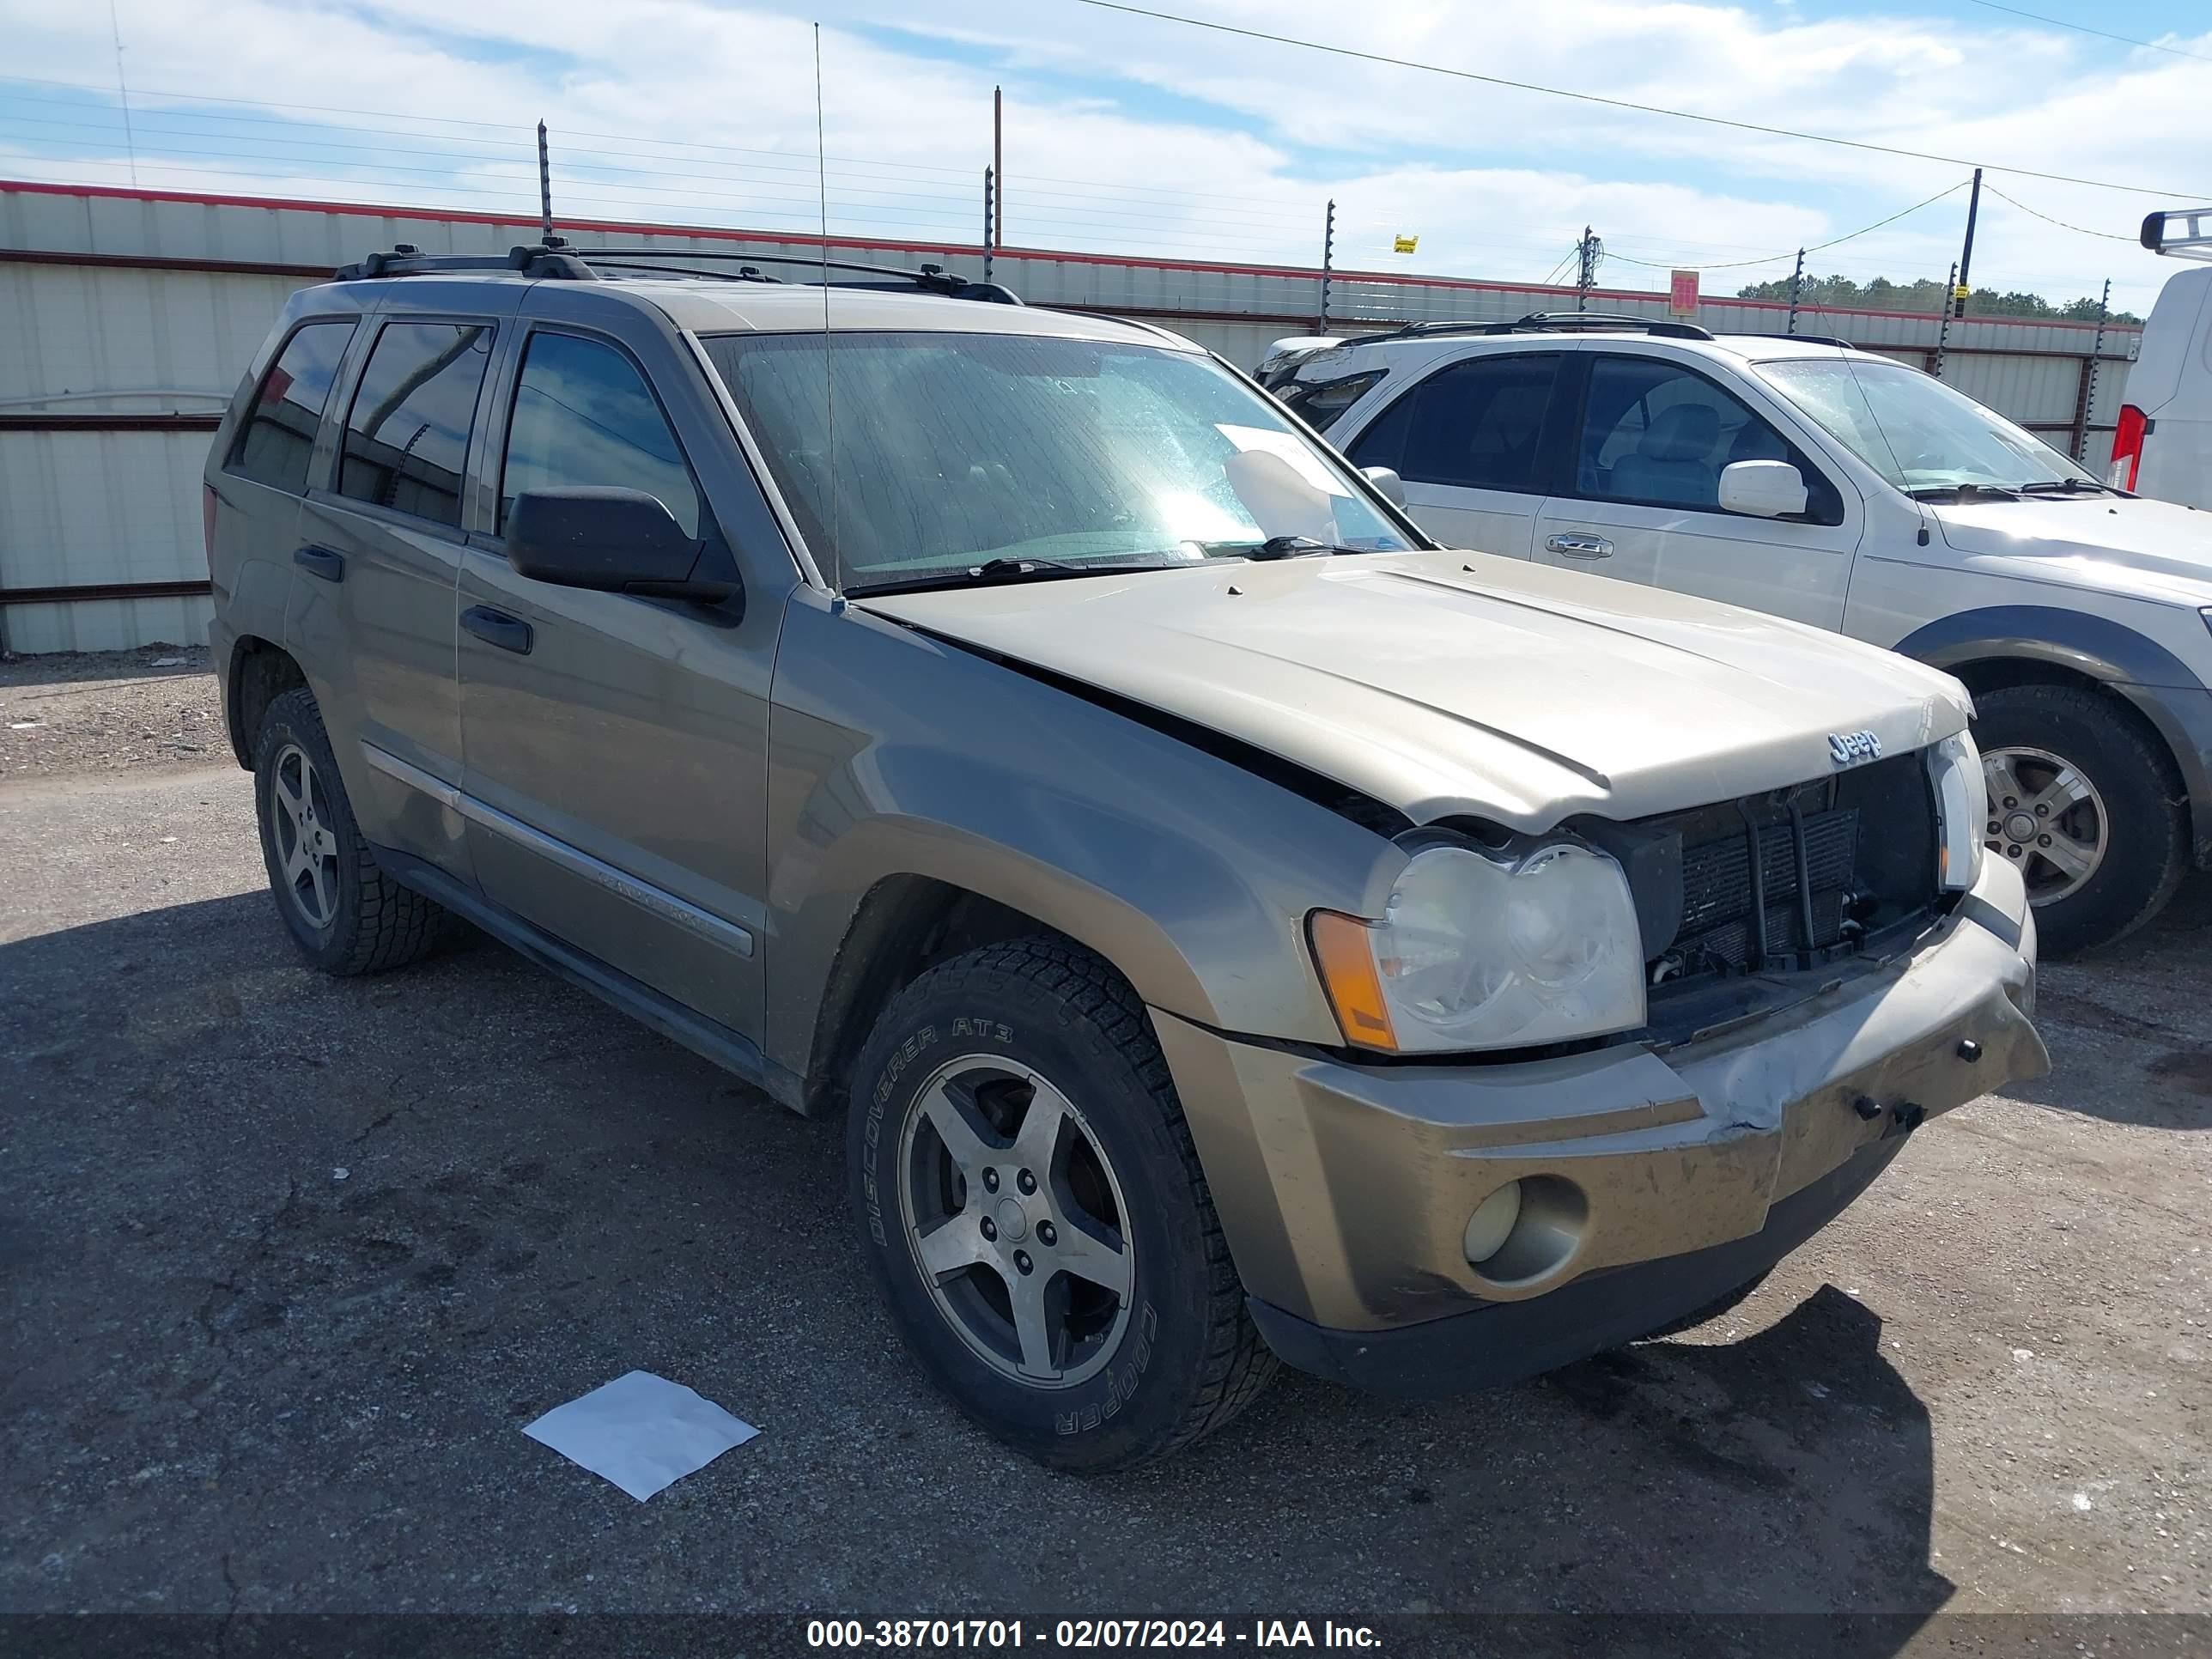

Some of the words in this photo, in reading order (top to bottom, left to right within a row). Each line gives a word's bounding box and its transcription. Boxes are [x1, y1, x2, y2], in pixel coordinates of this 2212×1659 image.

[1828, 730, 1881, 763] Jeep
[863, 1024, 939, 1247] DISCOVERER
[951, 1018, 1014, 1044] AT3
[1055, 1299, 1158, 1436] COOPER
